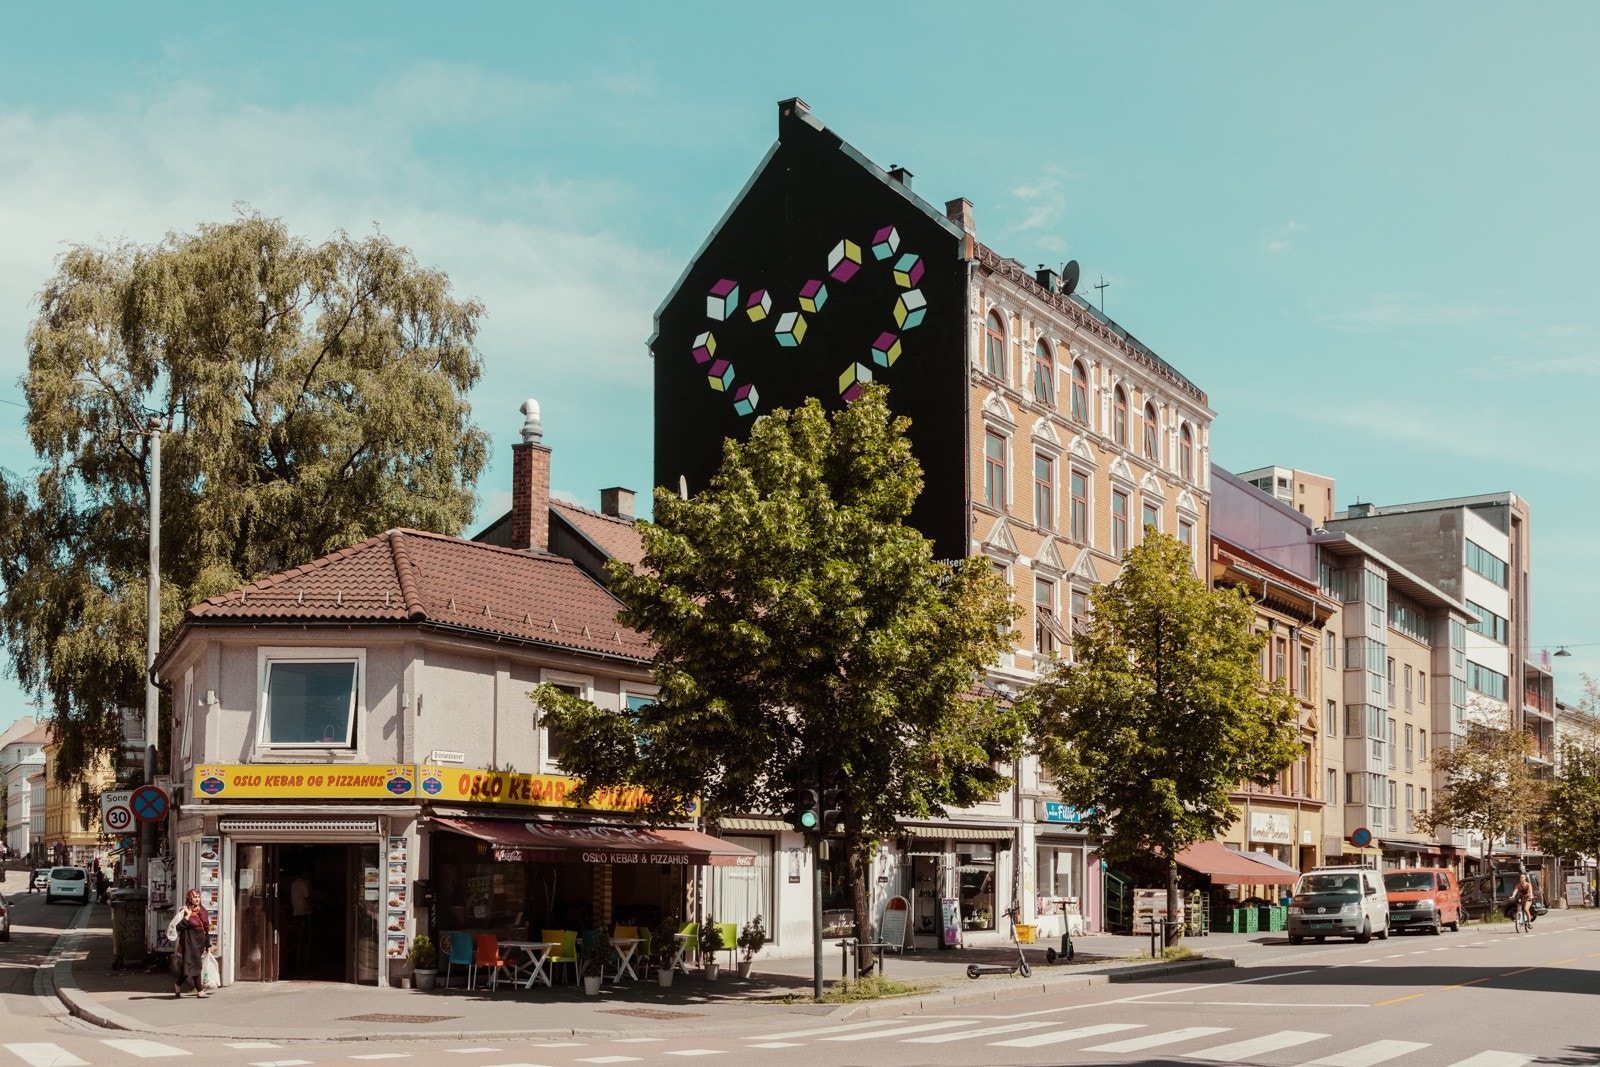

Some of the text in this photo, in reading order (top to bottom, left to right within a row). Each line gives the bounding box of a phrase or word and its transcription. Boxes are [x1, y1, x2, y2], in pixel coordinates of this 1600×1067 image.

[233, 775, 261, 787] OSLO
[265, 775, 303, 787] KEBAB
[307, 775, 323, 787] OG
[327, 775, 385, 787] PIZZAHUS
[458, 773, 503, 797] OSLO
[508, 776, 566, 802] KEBAB
[106, 794, 128, 802] Sone
[111, 811, 127, 824] 30
[582, 852, 689, 865] OSLO KEBAB & PIZZAHUS
